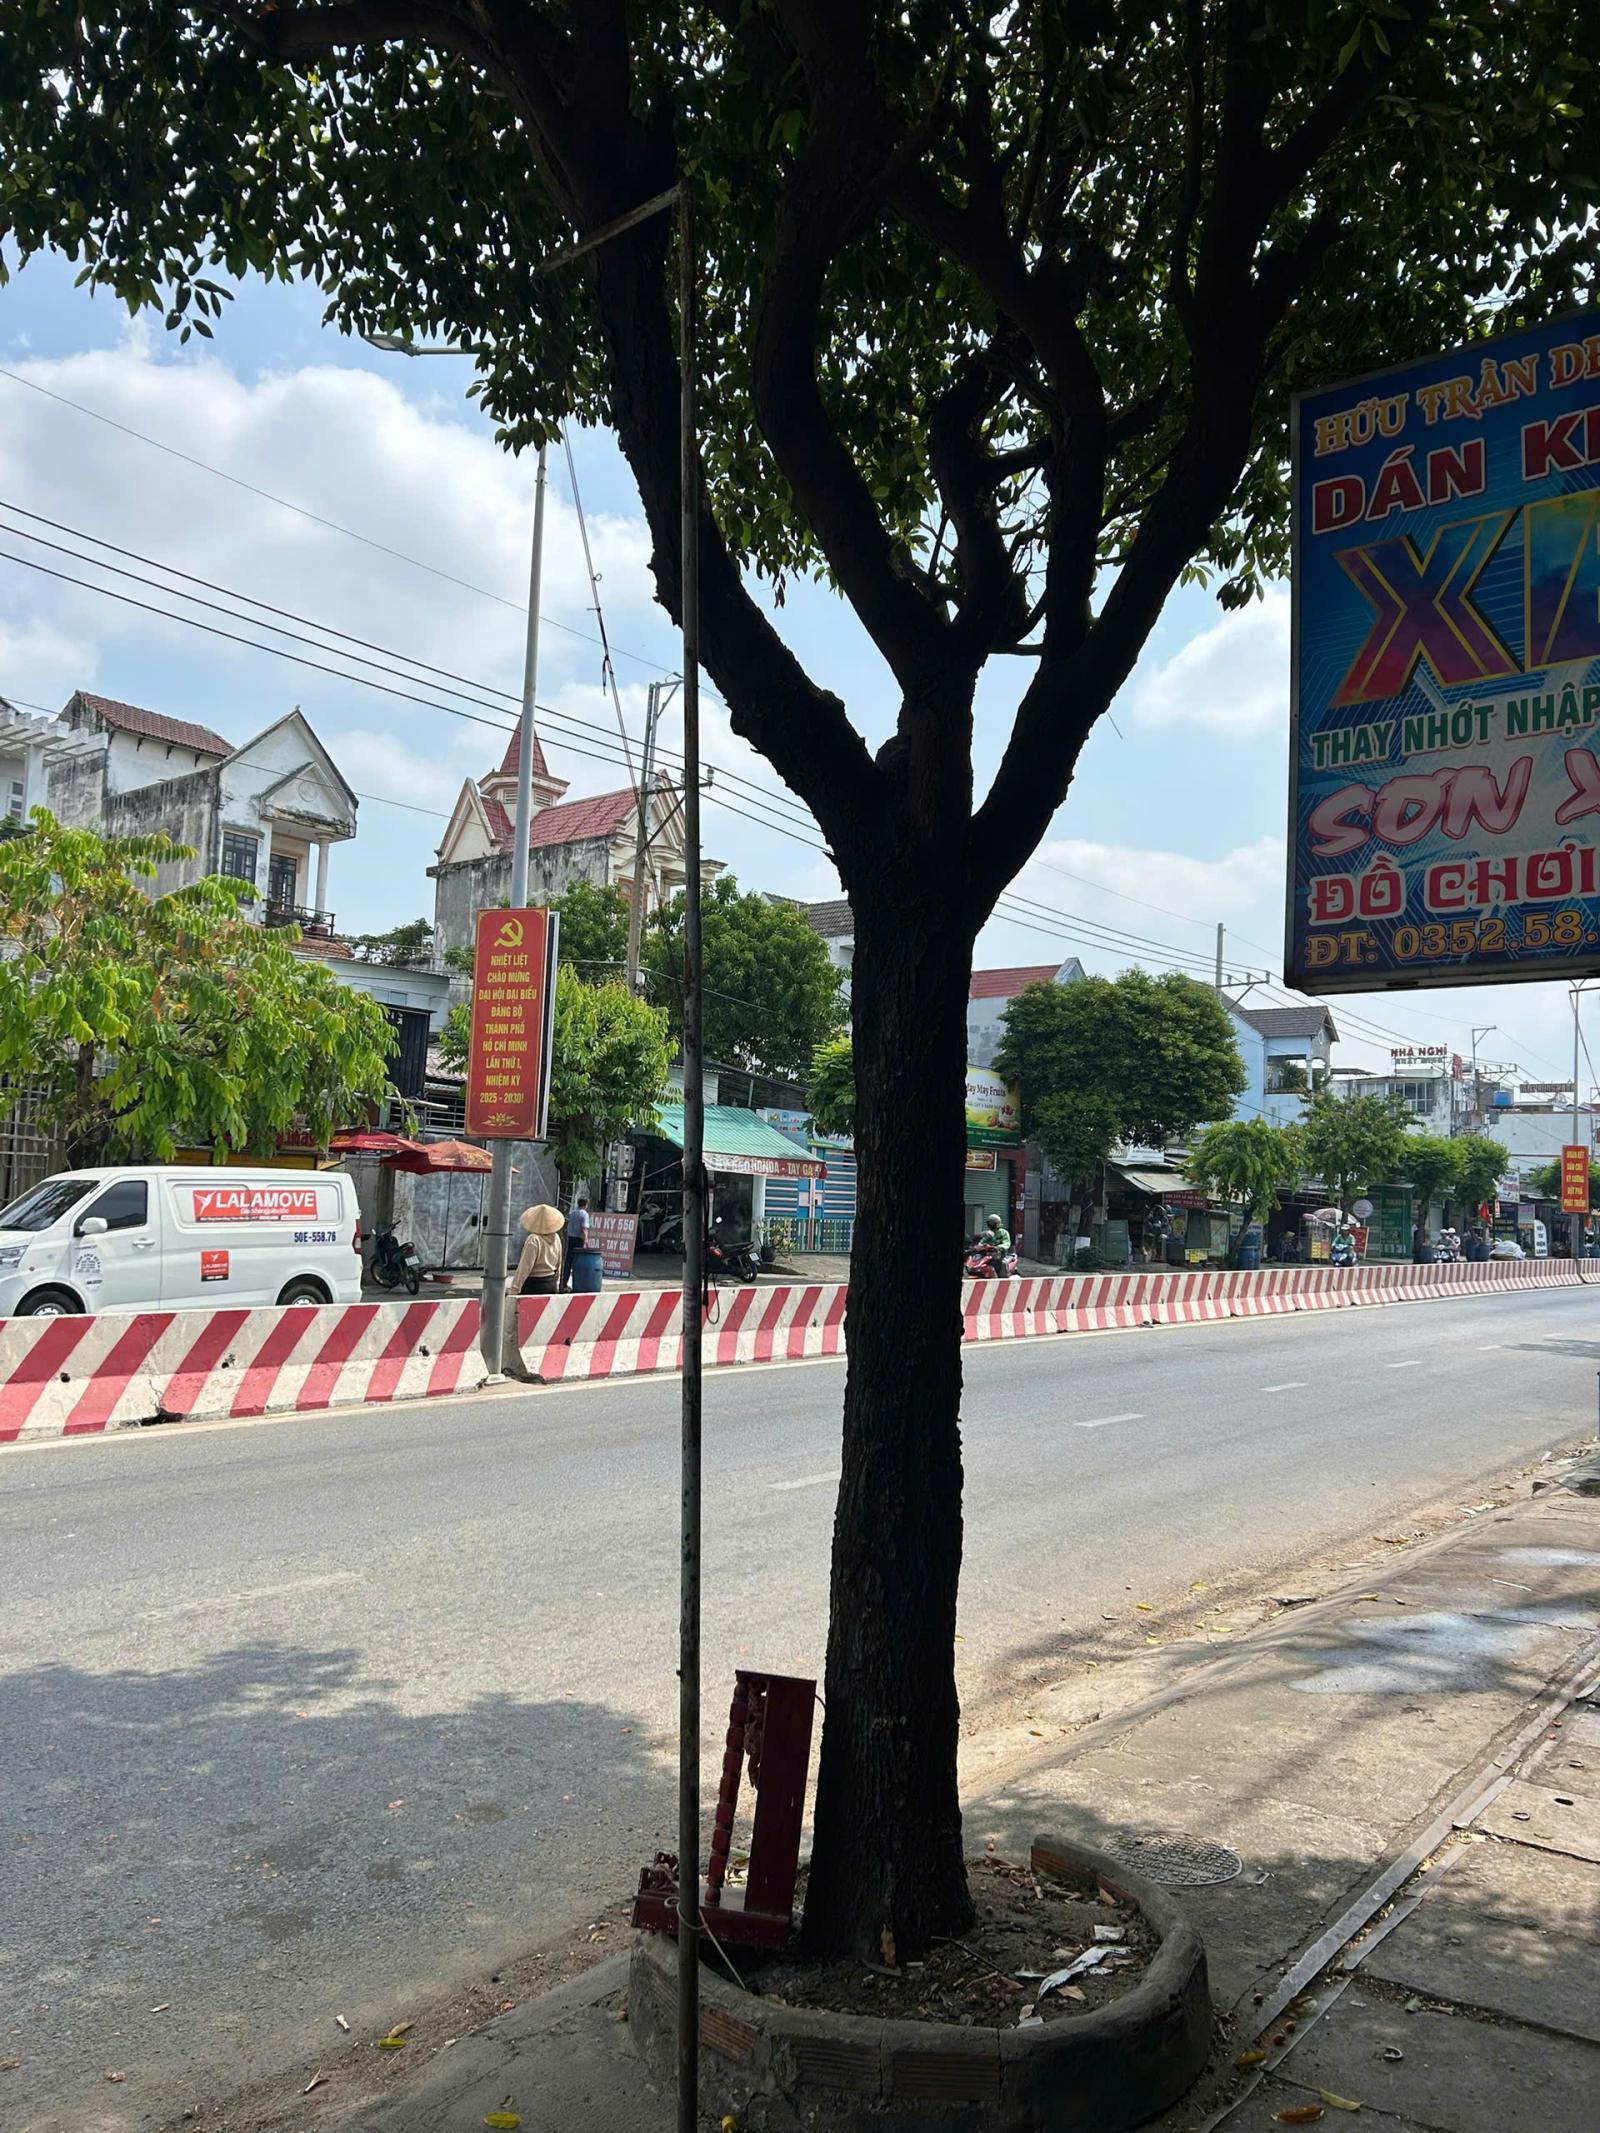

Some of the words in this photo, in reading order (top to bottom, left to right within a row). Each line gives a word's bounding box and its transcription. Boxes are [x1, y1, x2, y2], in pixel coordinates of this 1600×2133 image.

[1315, 394, 1409, 457] HỮU
[1418, 355, 1540, 425] TRẦN
[1313, 439, 1485, 534] DÁN
[1312, 721, 1393, 768] THAY
[1403, 702, 1495, 755] NHỚT
[1507, 682, 1600, 736] NHẬP
[1312, 855, 1403, 921] ĐỒ
[1429, 843, 1596, 909] CHƠI
[1306, 930, 1378, 968] ĐT:
[491, 953, 512, 968] NHIỆT
[513, 953, 528, 968] LIỆT
[487, 970, 507, 983] CHÀO
[508, 970, 530, 983] MỪNG
[479, 989, 491, 1002] ĐẠI
[493, 987, 505, 1002] HỘI
[506, 988, 519, 1002] ĐẠI
[491, 1003, 511, 1018] ĐẢNG
[513, 1004, 523, 1019] BỘ
[485, 1022, 509, 1034] THÀNH
[510, 1020, 525, 1034] PHỐ
[482, 1039, 493, 1051] HỒ
[494, 1038, 507, 1051] CHÍ
[508, 1041, 528, 1052] MINH
[1418, 1043, 1447, 1056] NGHỈ
[486, 1073, 509, 1088] NHIỆM
[480, 1092, 497, 1104] 2025
[787, 1162, 801, 1175] TAY
[215, 1192, 315, 1208] LALAMOVE
